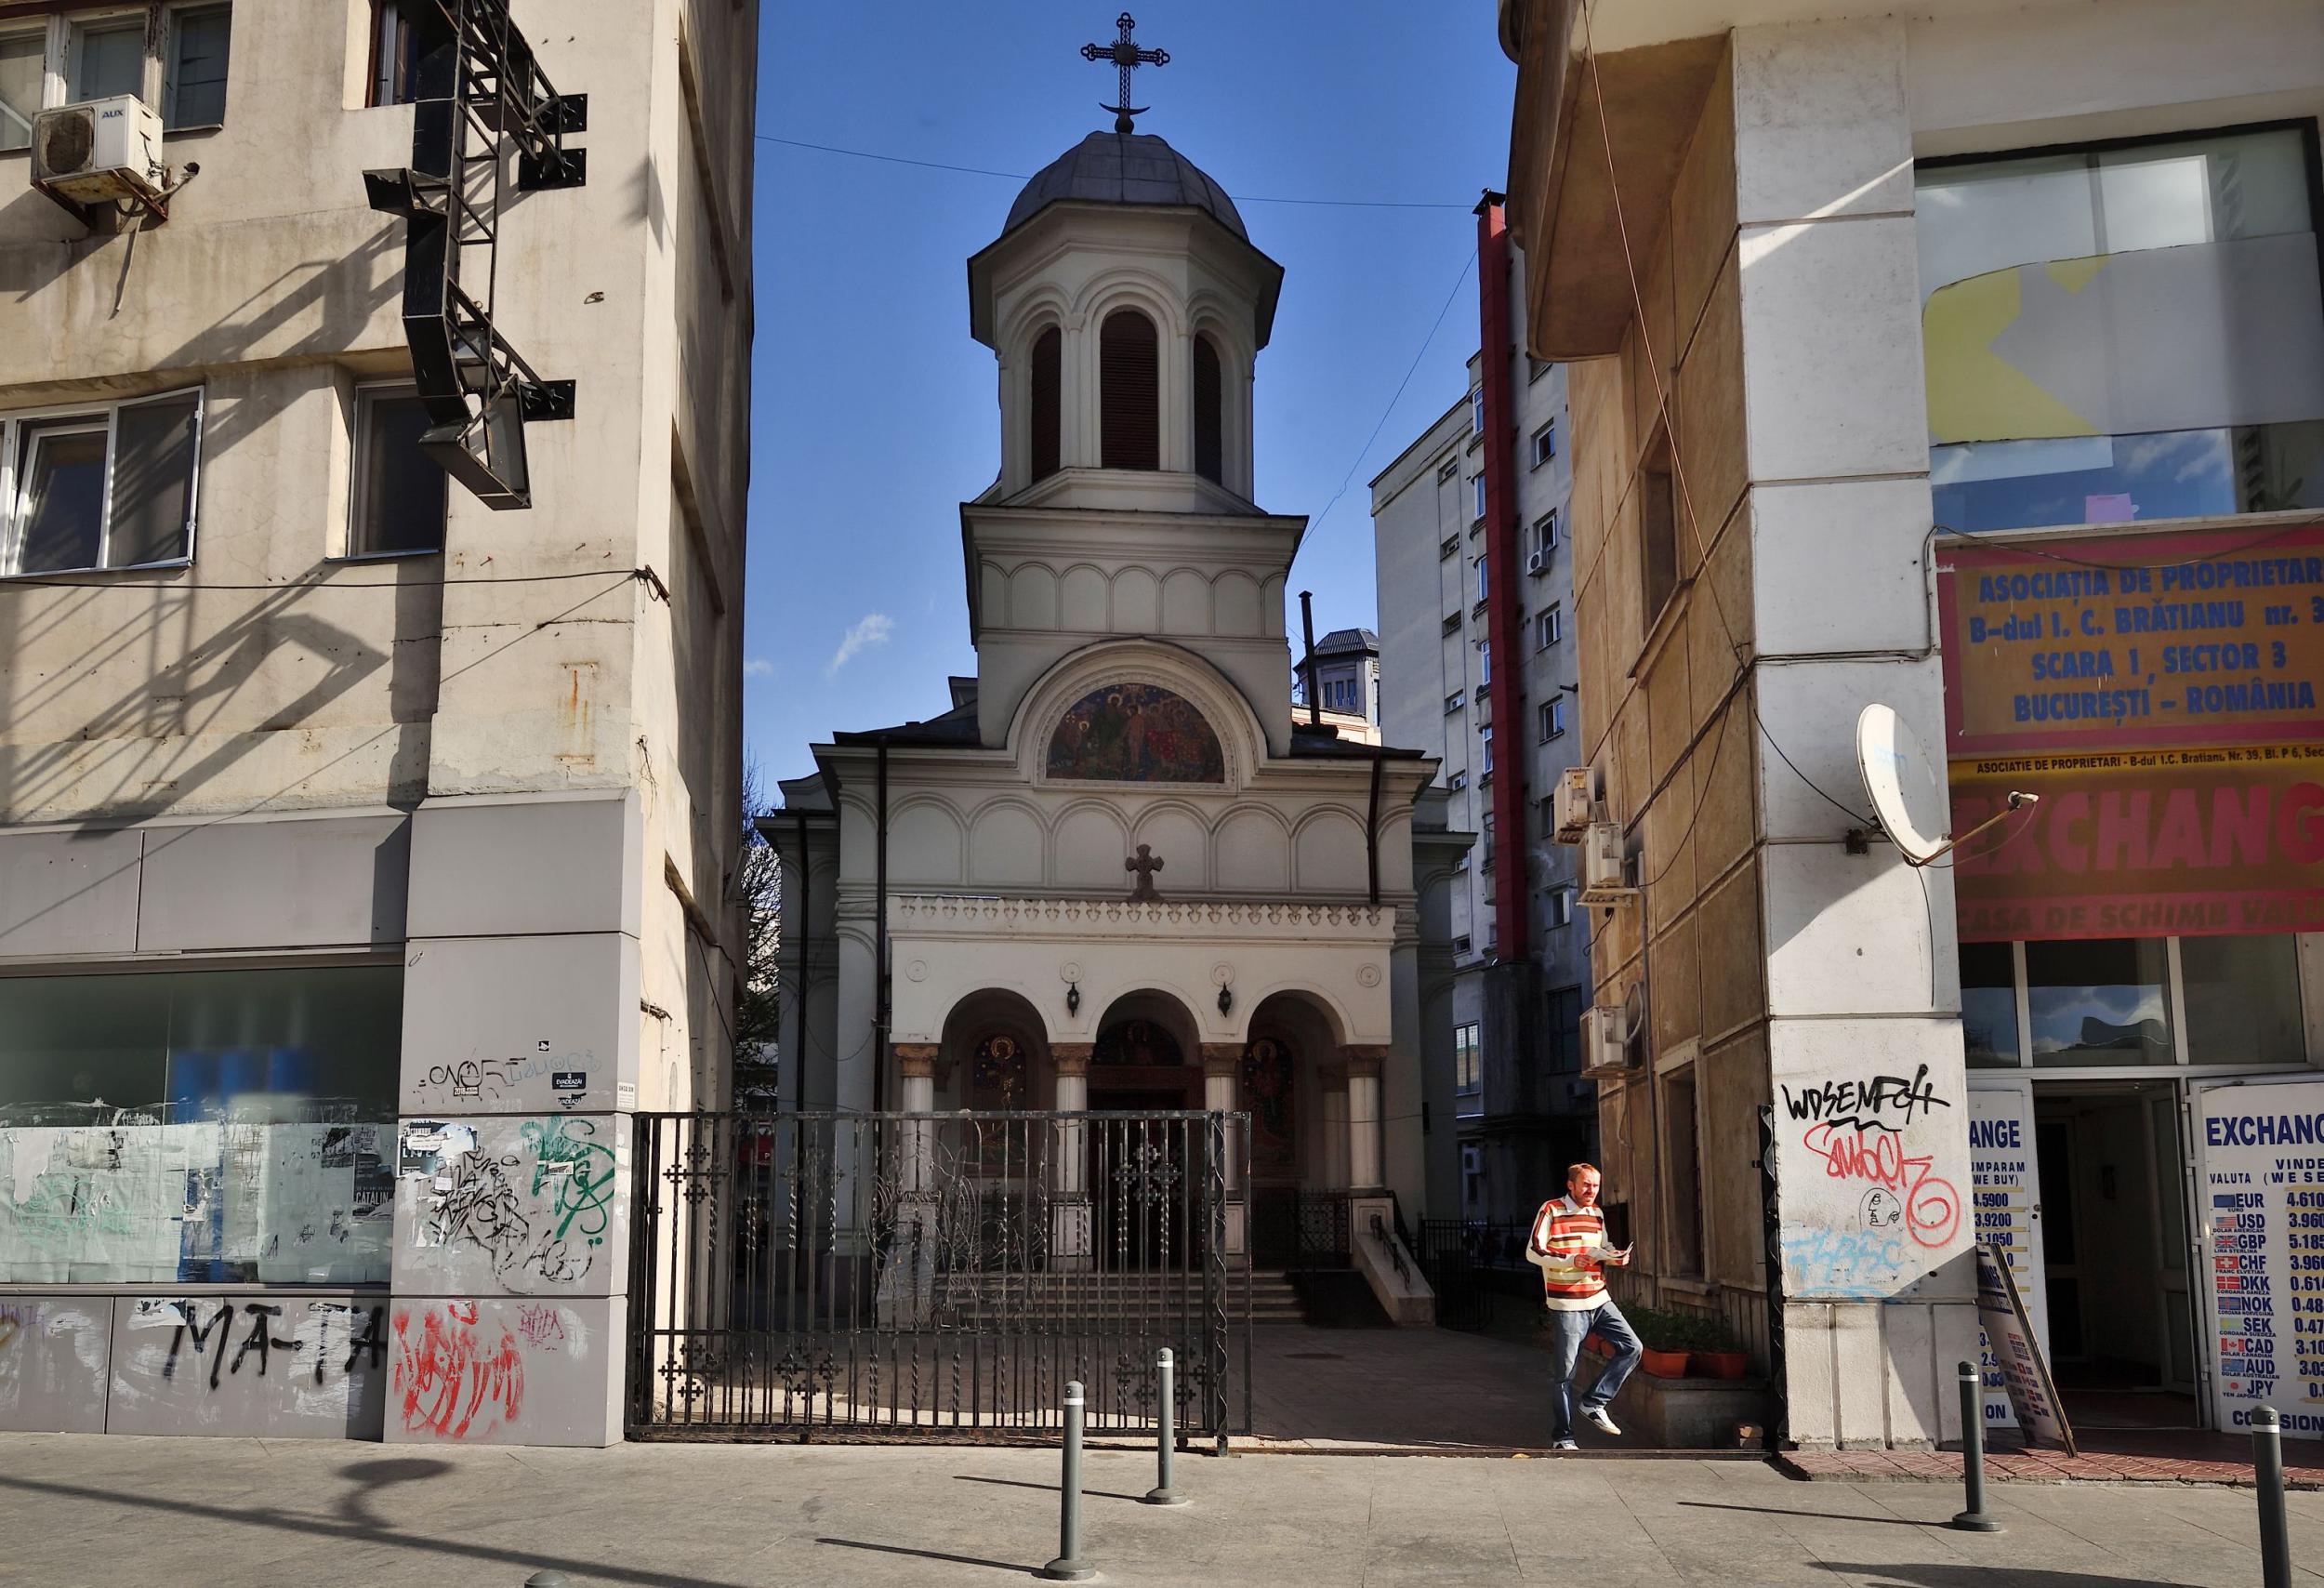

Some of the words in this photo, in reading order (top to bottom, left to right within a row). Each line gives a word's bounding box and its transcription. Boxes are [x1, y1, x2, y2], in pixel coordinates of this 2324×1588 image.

[101, 109, 124, 119] AUX
[1979, 570, 2110, 606] ASOCIAȚIA
[2119, 568, 2152, 594] DE
[1969, 613, 2041, 643] B-dul
[2052, 611, 2071, 638] I.
[2080, 609, 2105, 637] C.
[2265, 606, 2298, 626] nr.
[2031, 649, 2113, 681] SCARA
[2162, 642, 2260, 674] SECTOR
[2271, 641, 2286, 668] 3
[2014, 689, 2151, 727] BUCUREȘTI
[2185, 677, 2317, 715] ROMÂNIA
[1976, 760, 2032, 774] ASOCIATIE
[2035, 759, 2048, 771] DE
[2052, 756, 2121, 770] PROPRIETARI
[2131, 756, 2156, 767] B-dul
[2228, 750, 2243, 761] Nr.
[1954, 781, 2324, 876] EXCHANG
[2044, 905, 2088, 932] DE
[2100, 900, 2227, 930] SCHIMB
[1994, 1174, 2020, 1187] BUY)
[2210, 1172, 2251, 1184] VALUTA
[2235, 1193, 2265, 1209] EUR
[2237, 1213, 2265, 1228] USD
[2238, 1234, 2266, 1250] GBP
[2238, 1255, 2266, 1270] CHF
[2240, 1276, 2271, 1290] DKK
[2241, 1296, 2273, 1312] NOK
[2243, 1317, 2272, 1332] SEK
[2245, 1338, 2274, 1354] CAD
[2245, 1358, 2276, 1375] AUD
[2247, 1380, 2274, 1396] JPY
